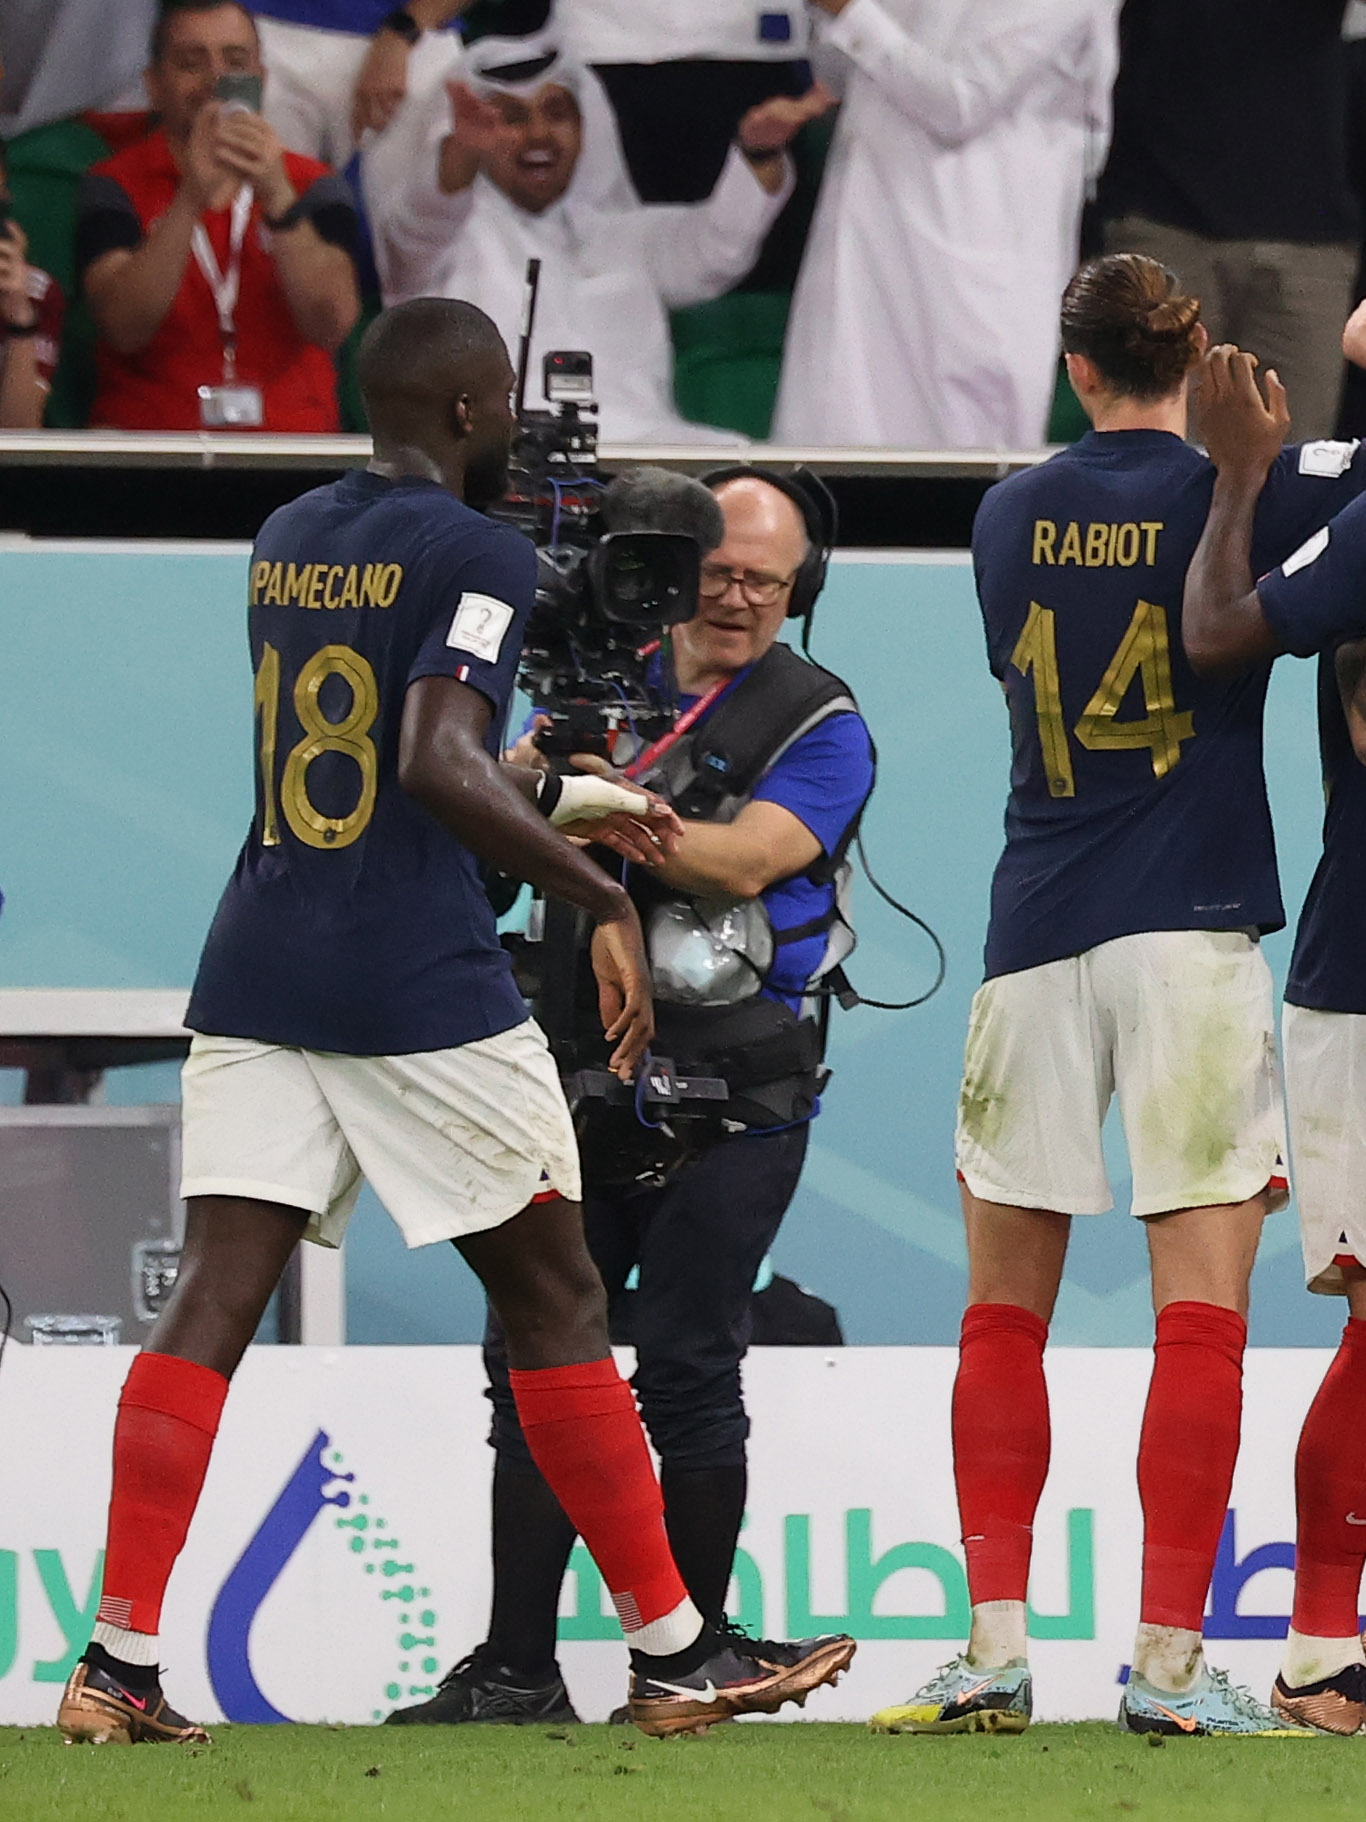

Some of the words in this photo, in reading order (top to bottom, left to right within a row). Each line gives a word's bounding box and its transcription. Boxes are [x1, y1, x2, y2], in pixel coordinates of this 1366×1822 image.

[1032, 519, 1164, 567] RABIOT
[255, 641, 379, 849] 18
[1010, 599, 1197, 798] 14
